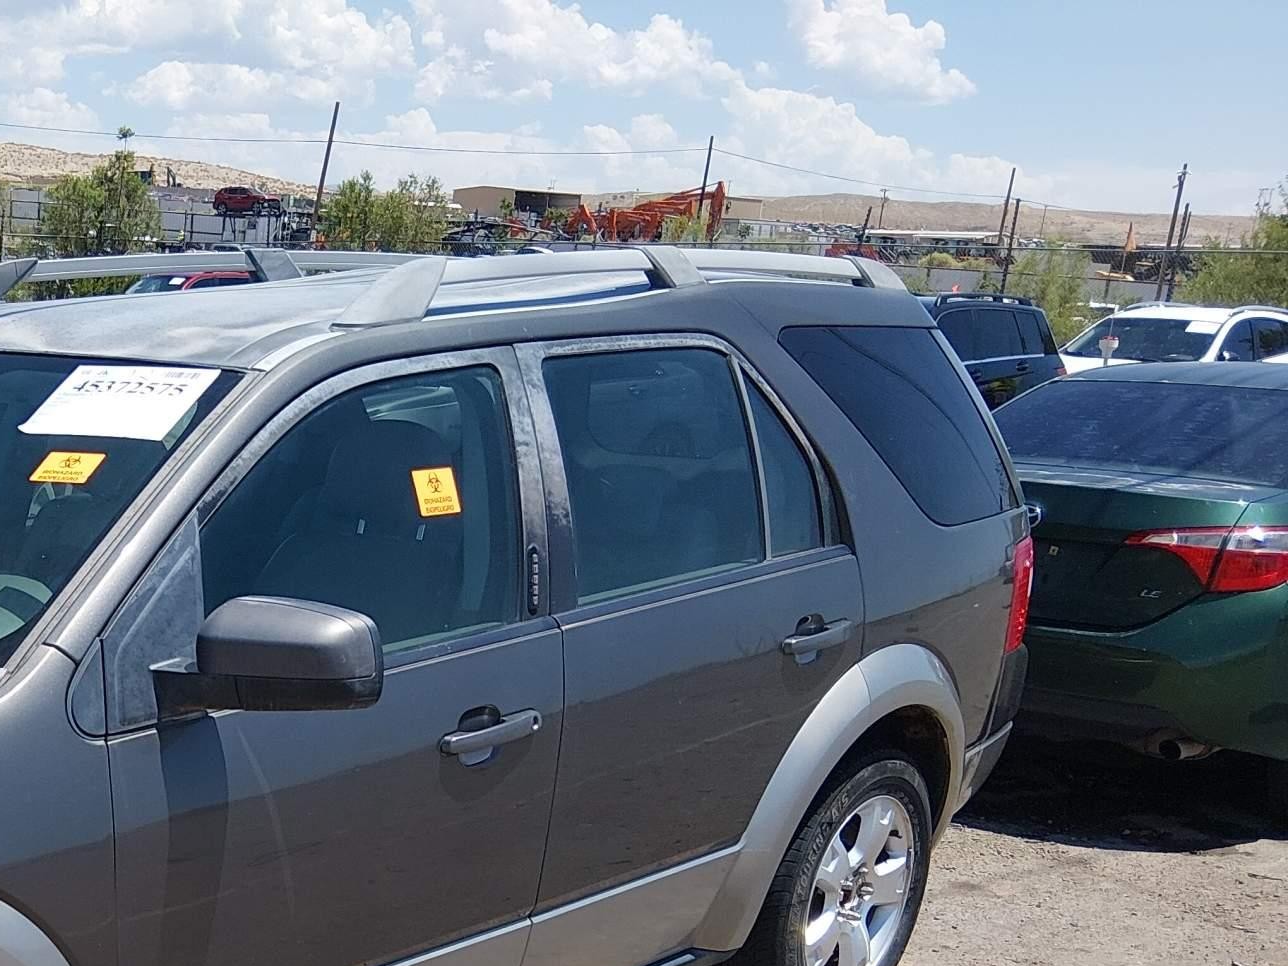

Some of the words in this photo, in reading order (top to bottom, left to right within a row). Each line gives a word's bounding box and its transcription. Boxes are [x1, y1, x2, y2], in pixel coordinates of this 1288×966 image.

[72, 380, 189, 396] 45372575
[424, 496, 453, 505] BIOHAZARD
[1140, 589, 1163, 598] LE
